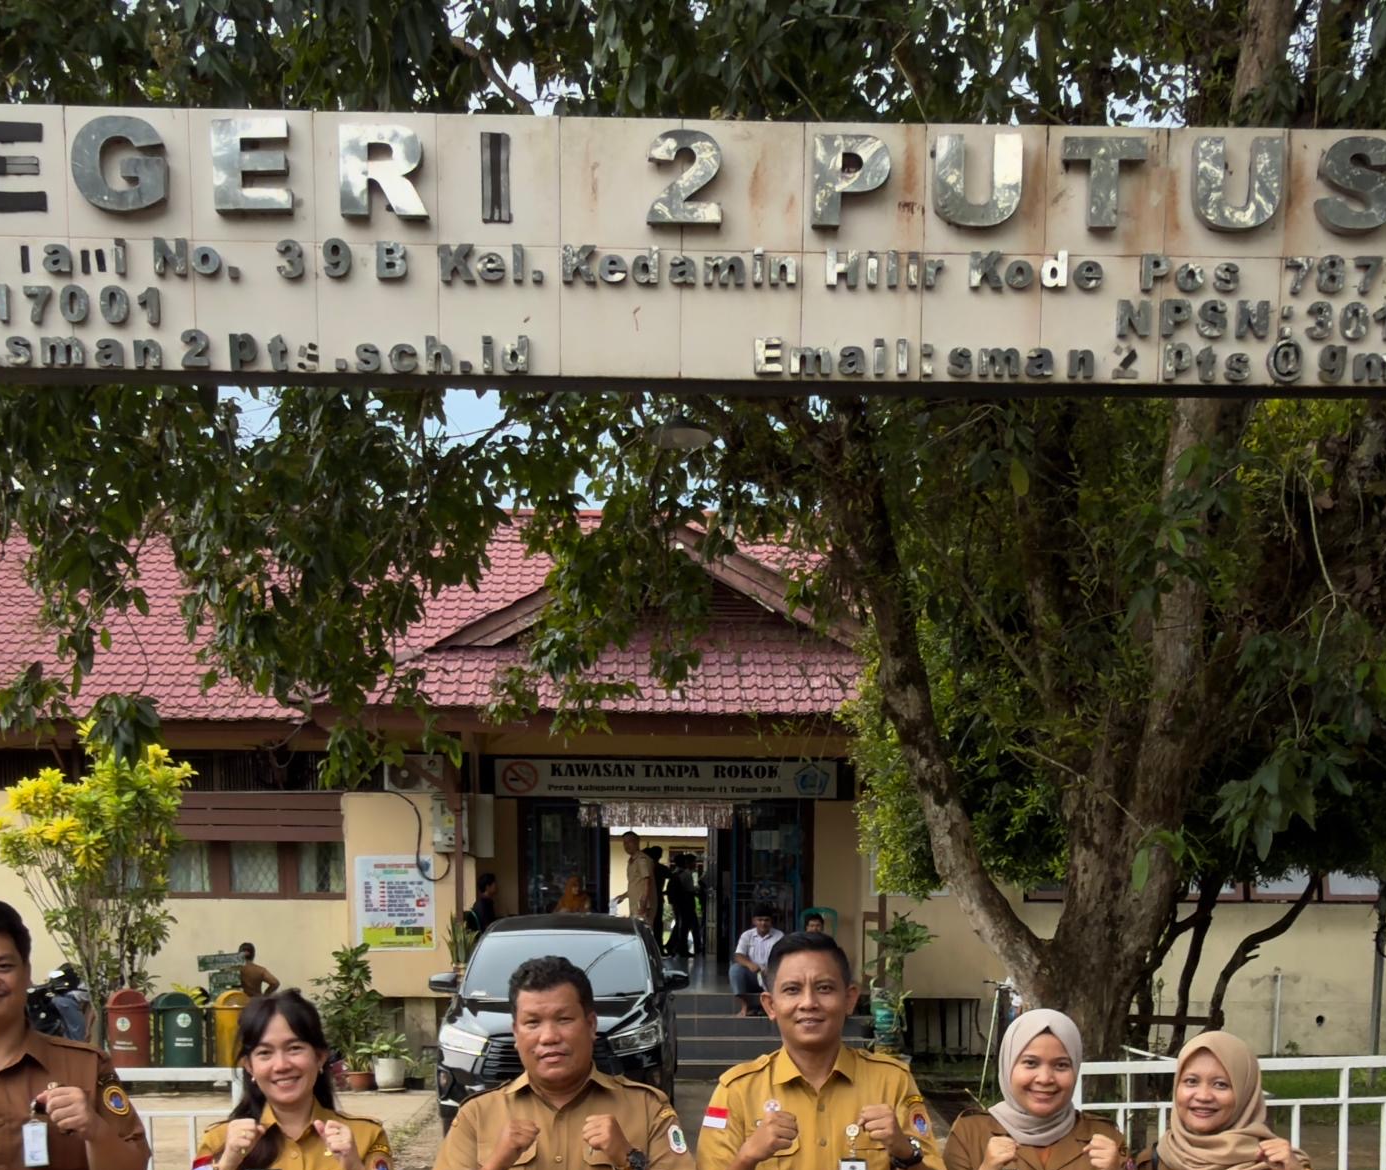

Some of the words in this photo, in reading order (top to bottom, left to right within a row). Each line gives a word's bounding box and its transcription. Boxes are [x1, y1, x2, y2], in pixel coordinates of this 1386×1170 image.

[645, 128, 724, 230] 2
[153, 236, 241, 280] No.
[437, 243, 545, 285] Kel.
[561, 244, 798, 289] Kedamin
[825, 249, 946, 290] Hilir
[968, 249, 1104, 291] Kode
[1139, 253, 1241, 293] Pos
[550, 762, 635, 778] KAWASAN
[644, 764, 701, 779] TANPA
[713, 764, 781, 780] ROKOK
